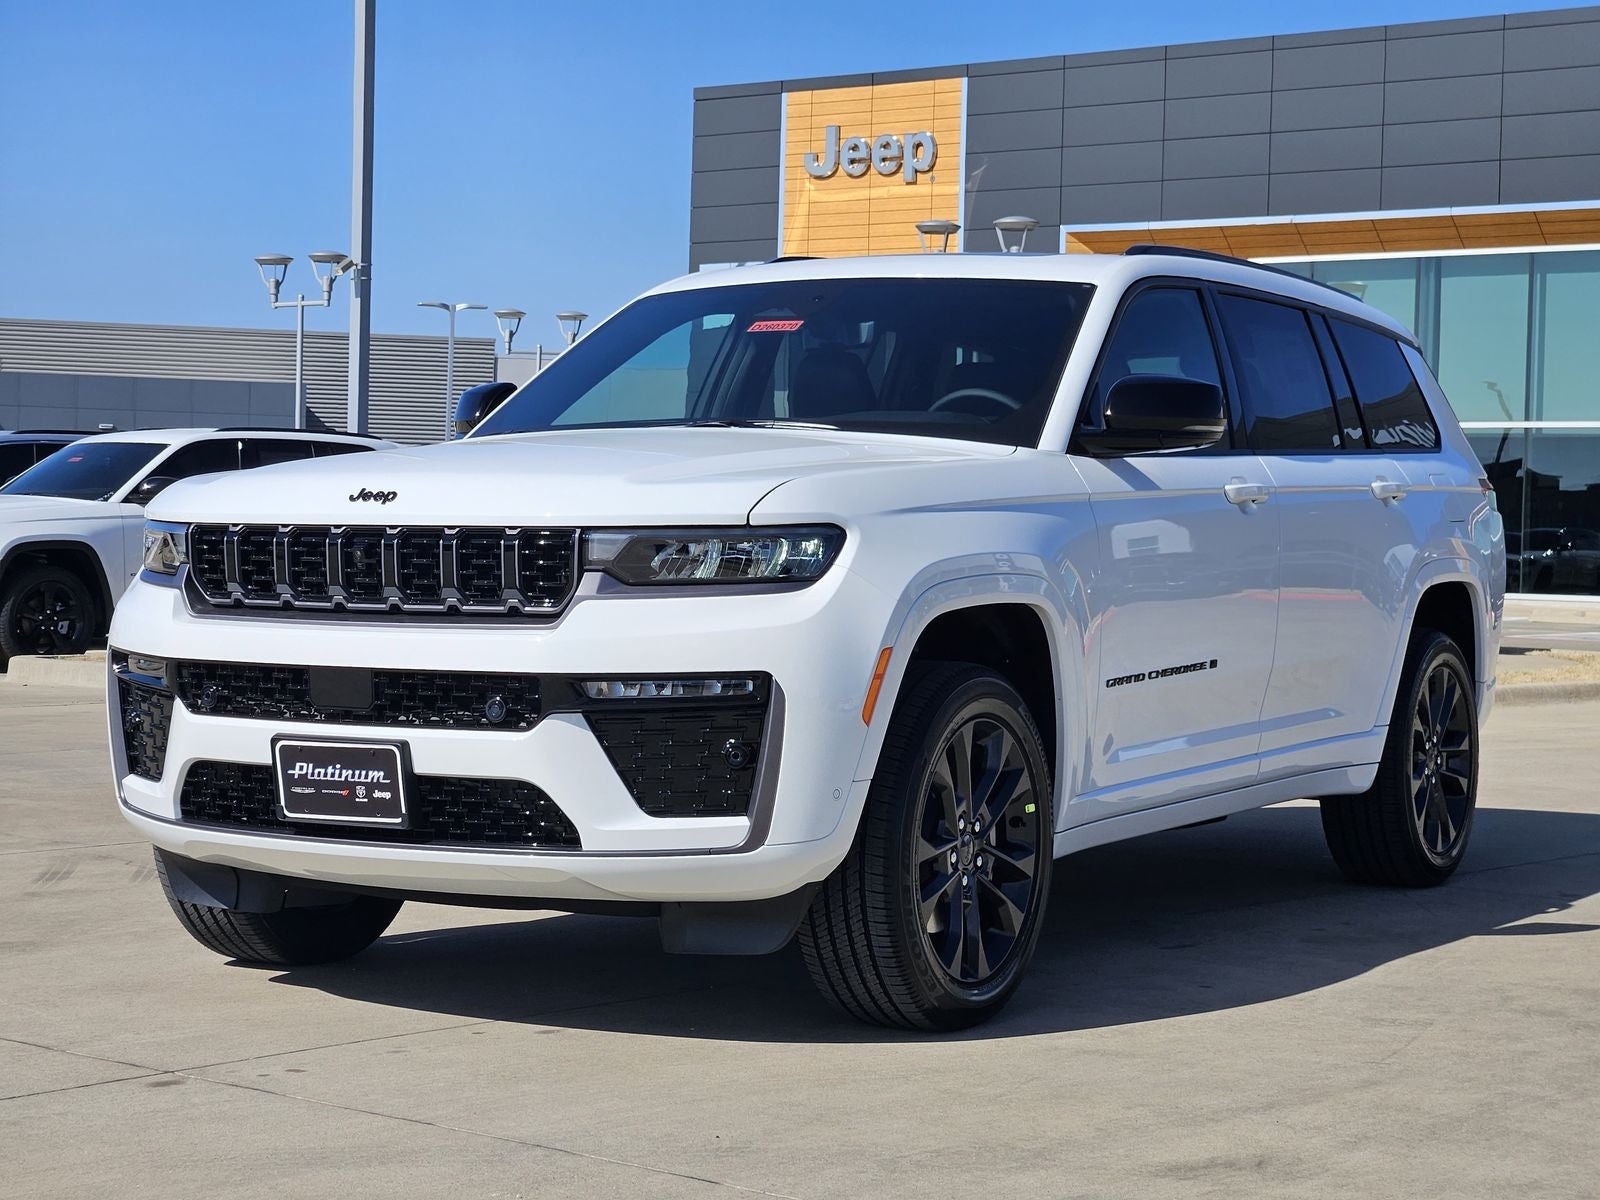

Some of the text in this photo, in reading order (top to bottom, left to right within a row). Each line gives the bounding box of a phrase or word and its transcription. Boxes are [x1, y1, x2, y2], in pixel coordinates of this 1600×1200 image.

[804, 125, 937, 185] Jeep
[348, 487, 398, 505] Jeep
[1105, 673, 1146, 688] GRAND
[1147, 661, 1208, 680] CHEROKEE
[287, 762, 391, 783] Platinum
[372, 789, 392, 800] Jeep
